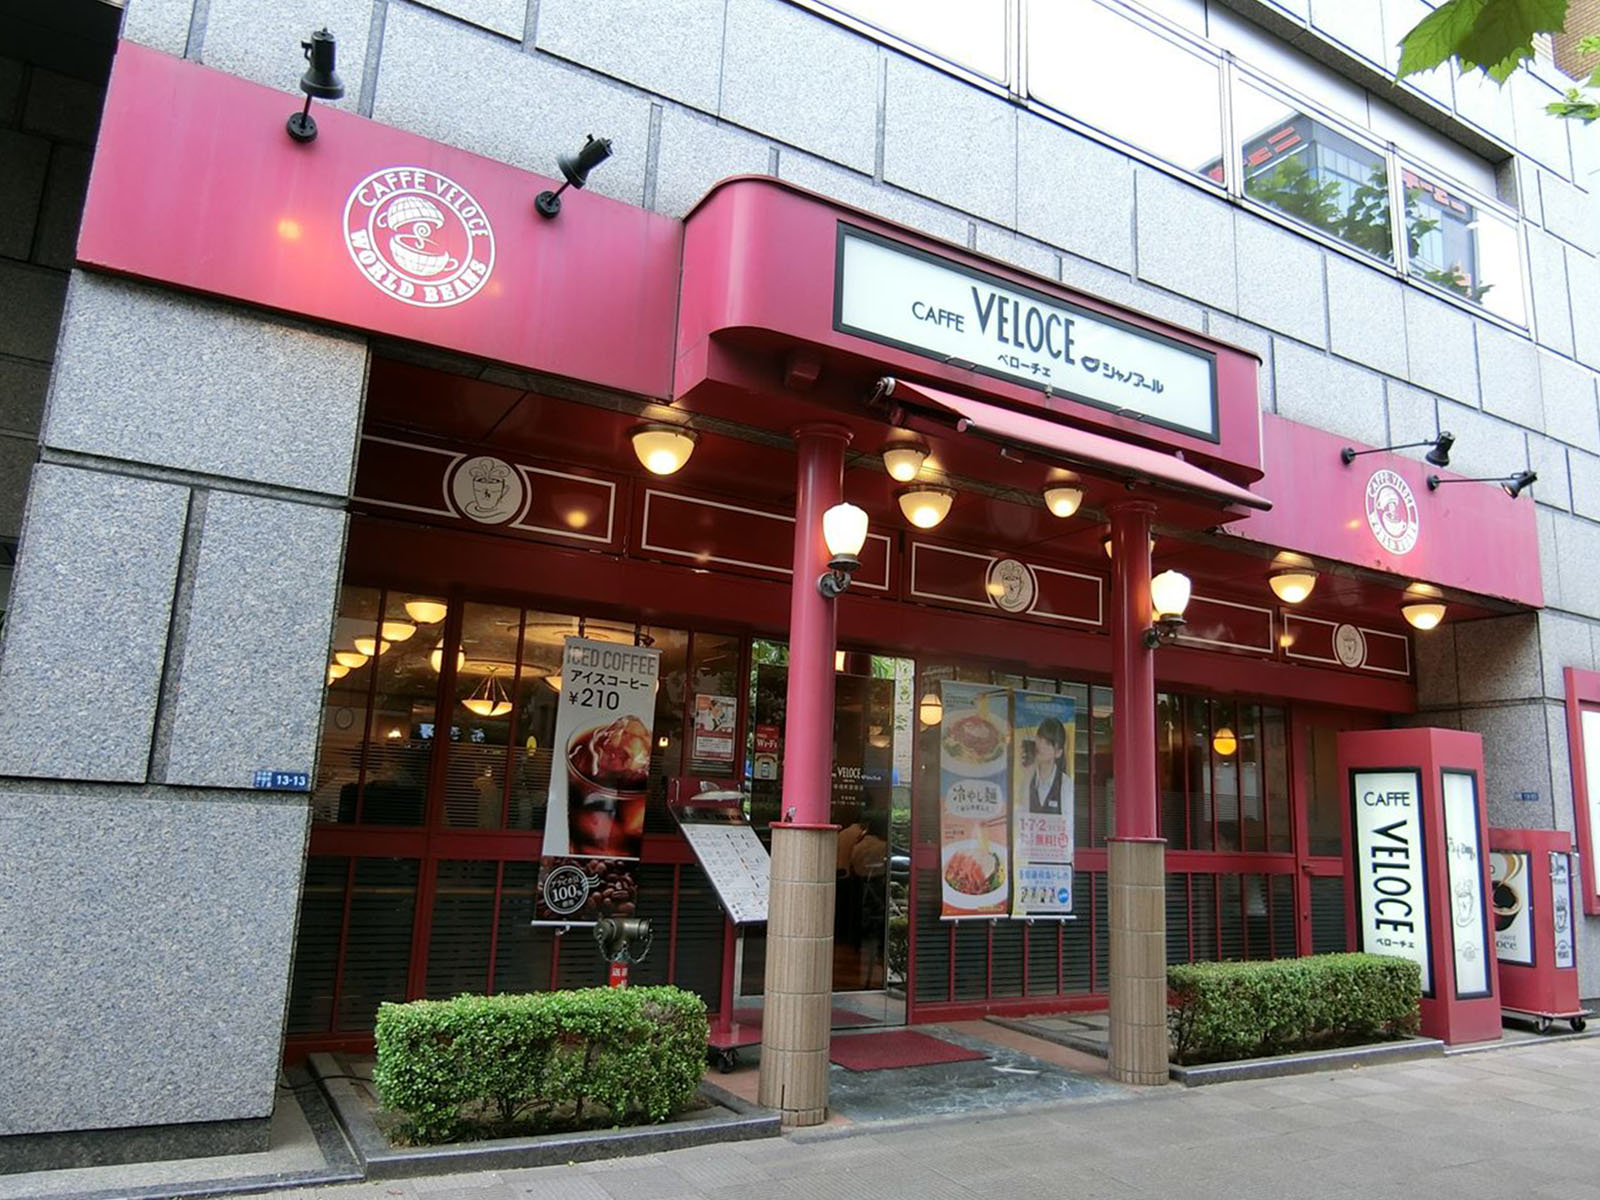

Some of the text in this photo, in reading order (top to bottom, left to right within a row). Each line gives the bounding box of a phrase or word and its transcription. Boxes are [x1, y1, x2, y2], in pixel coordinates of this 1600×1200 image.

[358, 171, 489, 237] CAFFE VELOCE
[350, 229, 487, 302] WORLD BEANS
[911, 286, 1075, 365] CAFFE VELOCE
[997, 353, 1164, 394] ベローチェ シャノアール
[567, 645, 657, 676] ICED COFFEE
[570, 669, 649, 690] アイスコーヒー
[568, 688, 620, 710] ¥210
[276, 774, 306, 786] 13-13
[837, 766, 861, 779] VELOCE
[1363, 791, 1411, 807] CAFFE
[1370, 819, 1415, 934] VELOCE
[1376, 938, 1415, 948] ベローチェ
